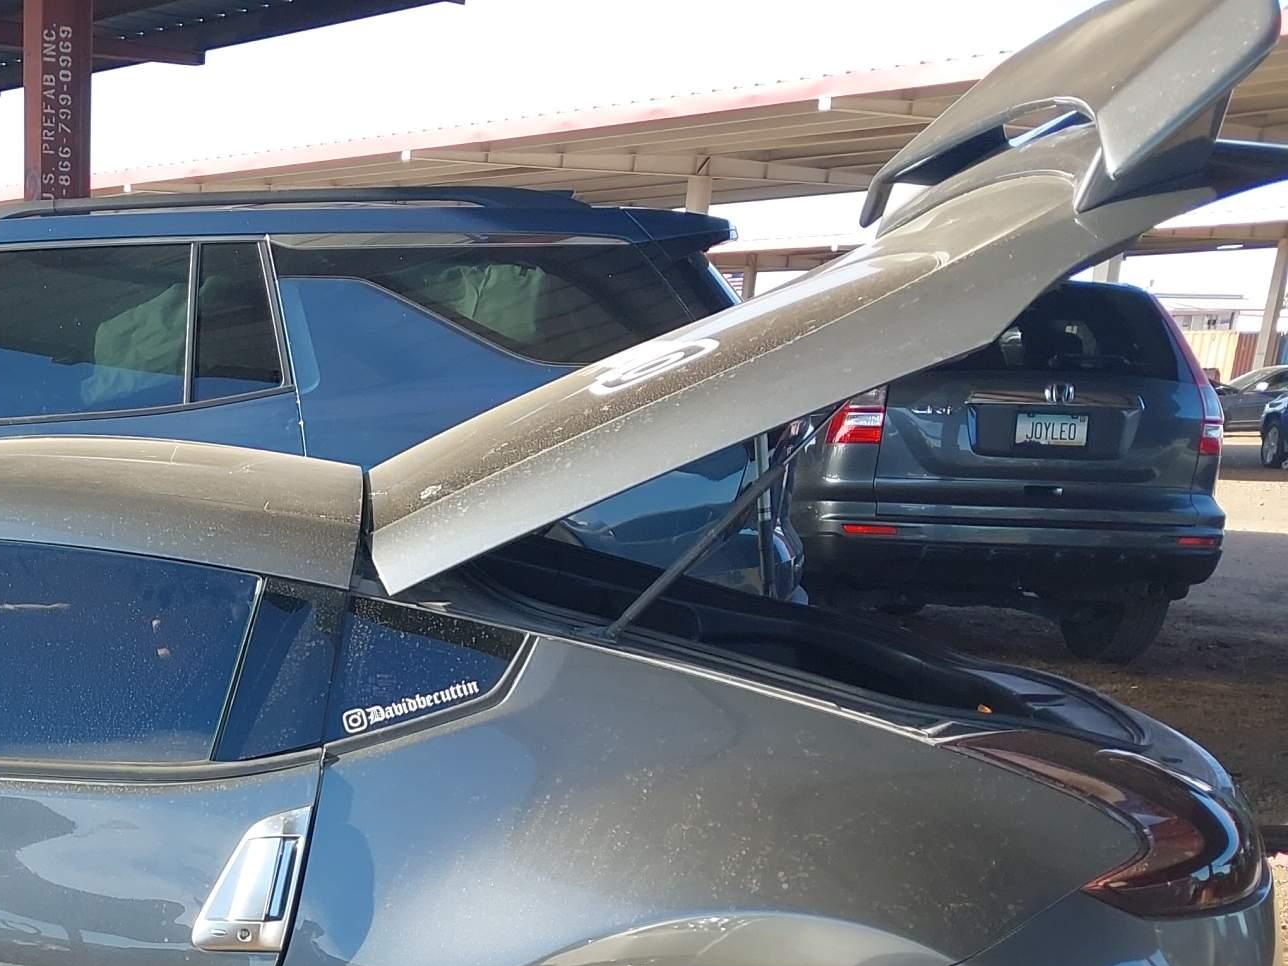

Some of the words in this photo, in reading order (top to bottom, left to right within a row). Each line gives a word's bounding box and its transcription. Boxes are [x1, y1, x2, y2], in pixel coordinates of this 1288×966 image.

[43, 23, 57, 62] INC.
[42, 74, 56, 154] PREFAB
[58, 25, 73, 198] -866-799-0969
